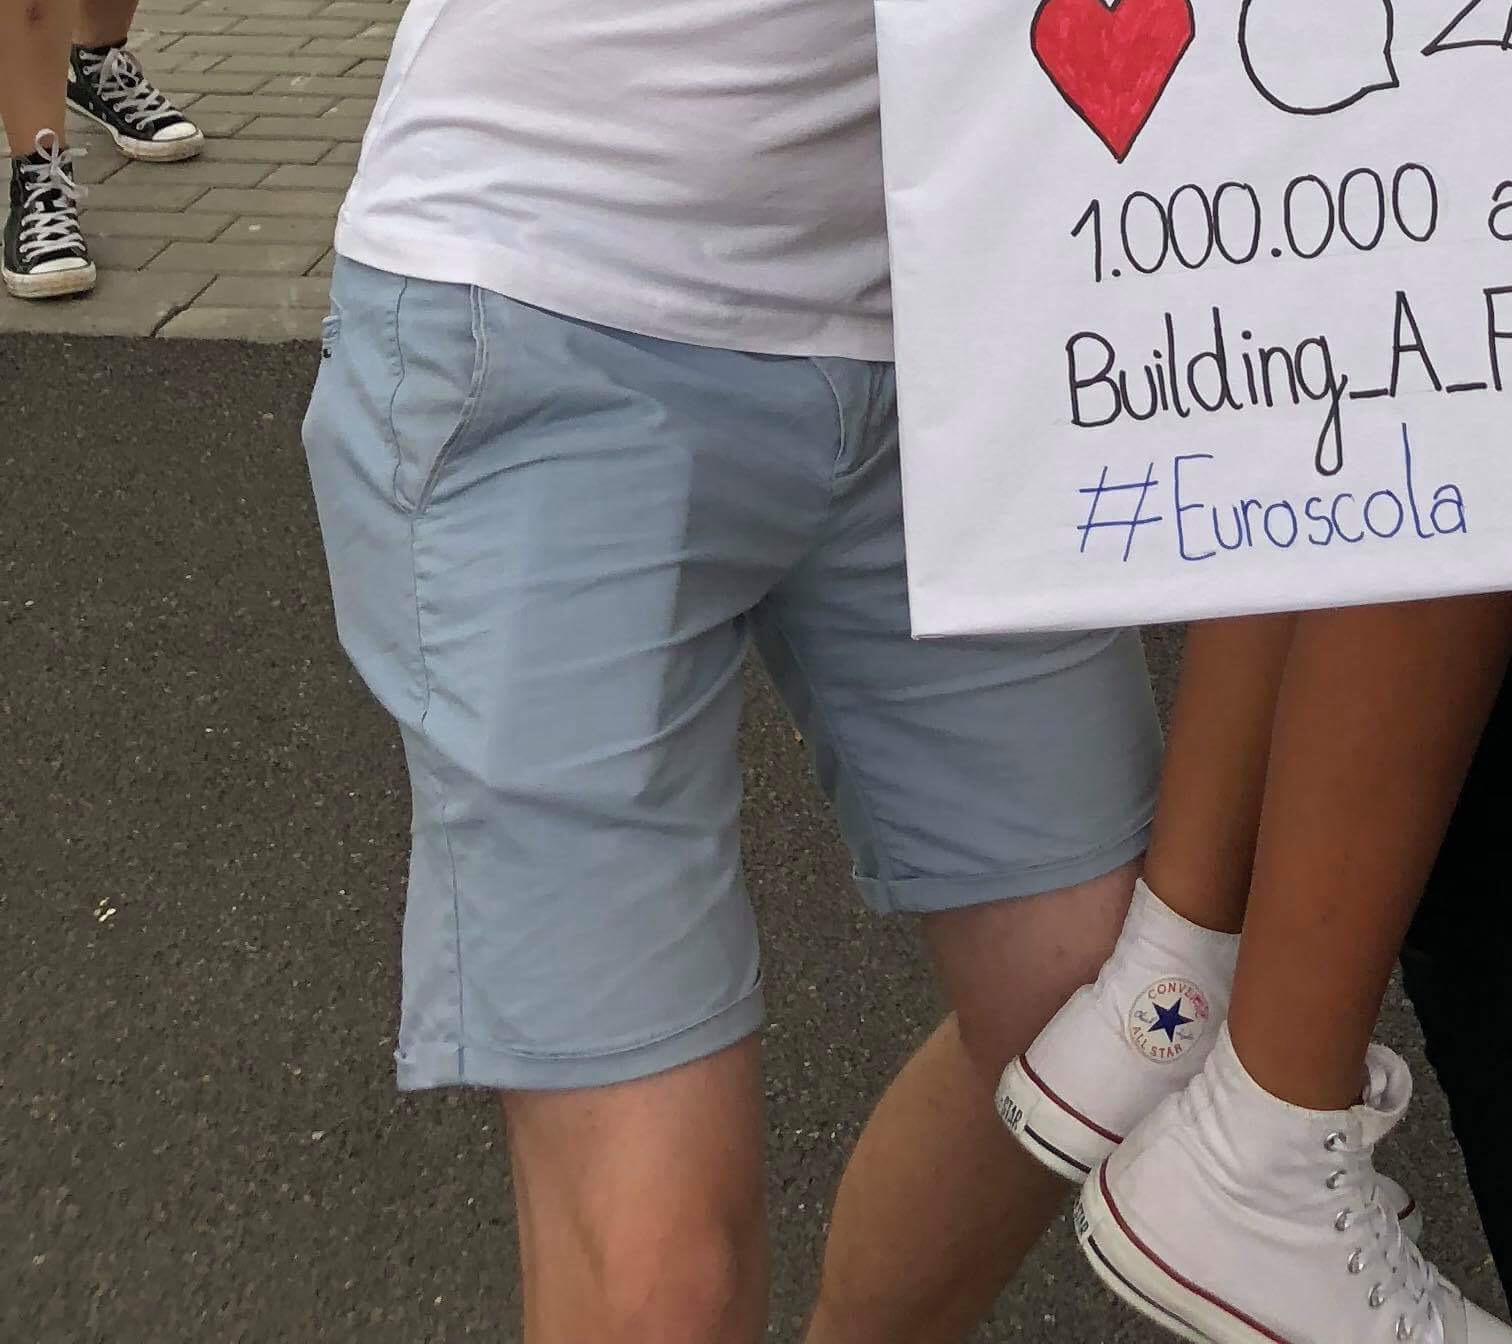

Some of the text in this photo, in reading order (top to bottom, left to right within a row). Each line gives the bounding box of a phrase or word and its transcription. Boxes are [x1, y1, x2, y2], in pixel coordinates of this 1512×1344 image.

[1070, 162, 1439, 282] 1.000.000
[1076, 422, 1469, 562] #Euroscola
[1150, 1043, 1183, 1059] STAR
